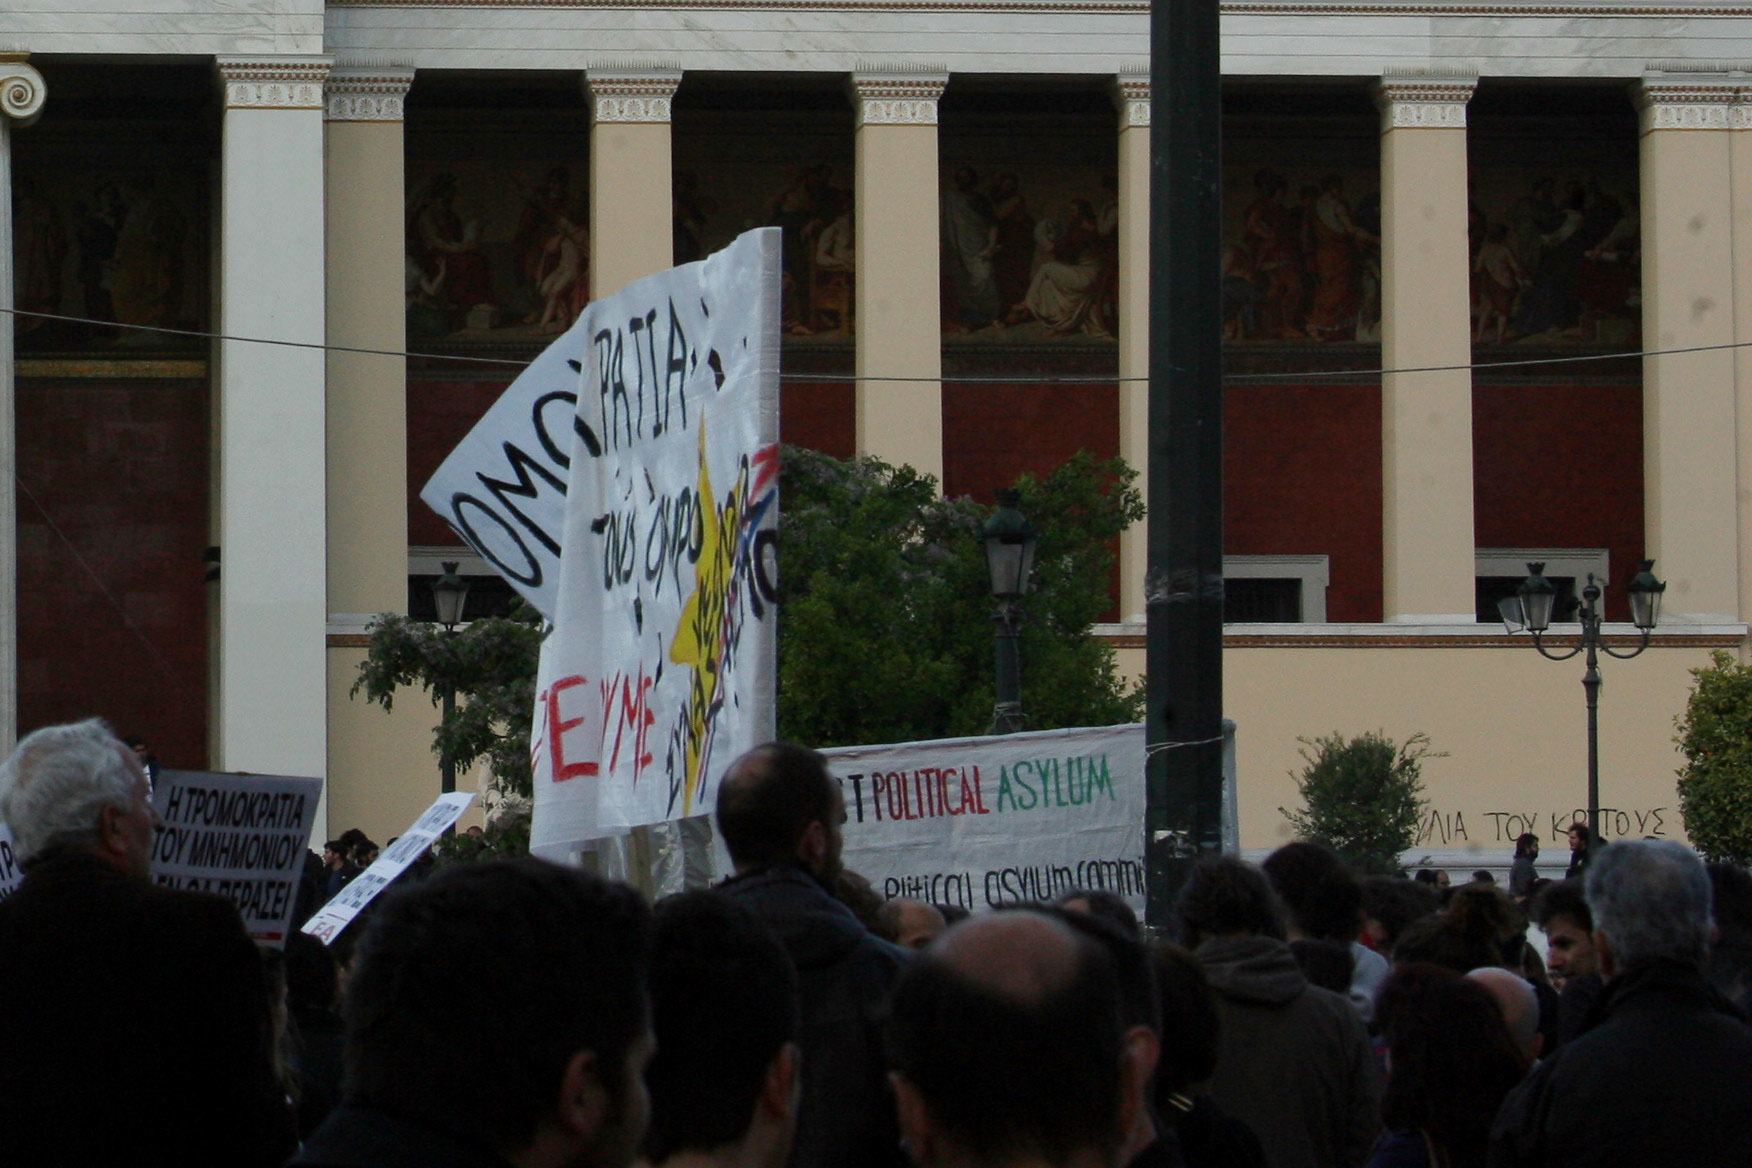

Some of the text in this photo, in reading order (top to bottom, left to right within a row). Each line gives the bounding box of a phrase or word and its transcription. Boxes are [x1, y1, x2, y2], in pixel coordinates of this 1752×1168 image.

[165, 785, 305, 830] Η ΤΡΟΜΟΚΡΑΤΙΑ
[872, 765, 989, 821] POLITICAL
[998, 753, 1115, 812] ASYLUM
[151, 823, 304, 870] ΤΟΥ ΜΝΗΜΟΝΙΟΥ
[1483, 811, 1538, 842] ΤΟΥ
[1550, 807, 1668, 842] ΚΡΤΟΥΣ
